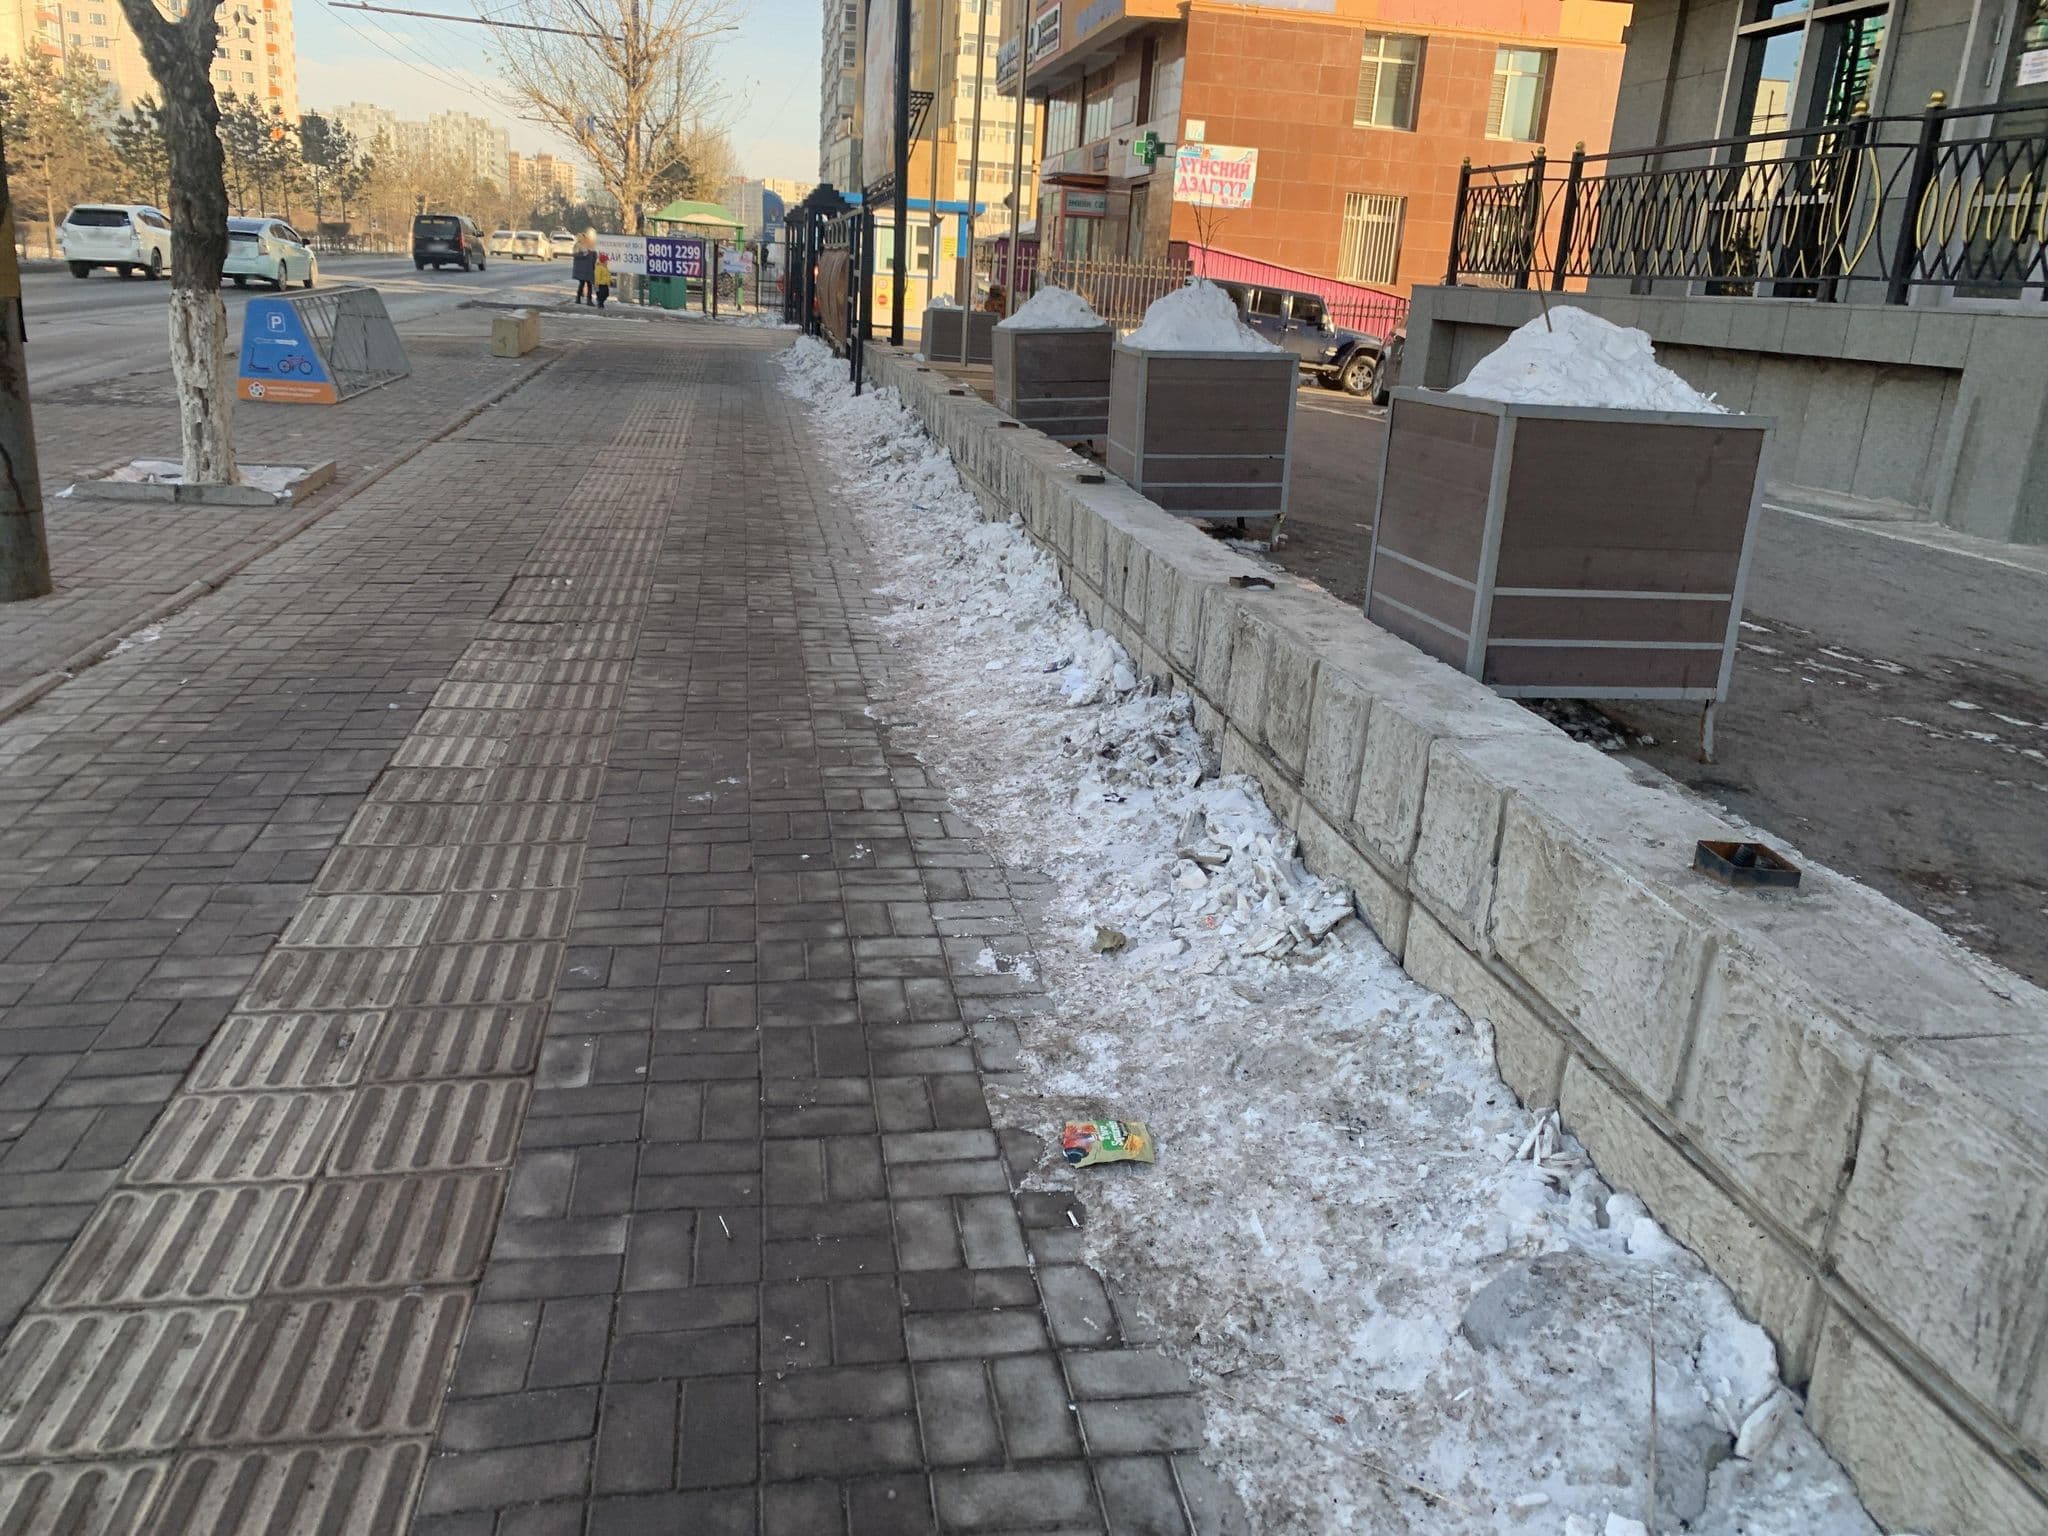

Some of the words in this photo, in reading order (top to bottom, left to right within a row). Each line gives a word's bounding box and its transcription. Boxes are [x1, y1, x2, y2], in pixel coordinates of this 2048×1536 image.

[648, 243, 672, 258] 9801
[675, 245, 701, 260] 2299
[649, 259, 673, 274] 9801
[676, 261, 700, 276] 5577
[271, 315, 282, 330] P
